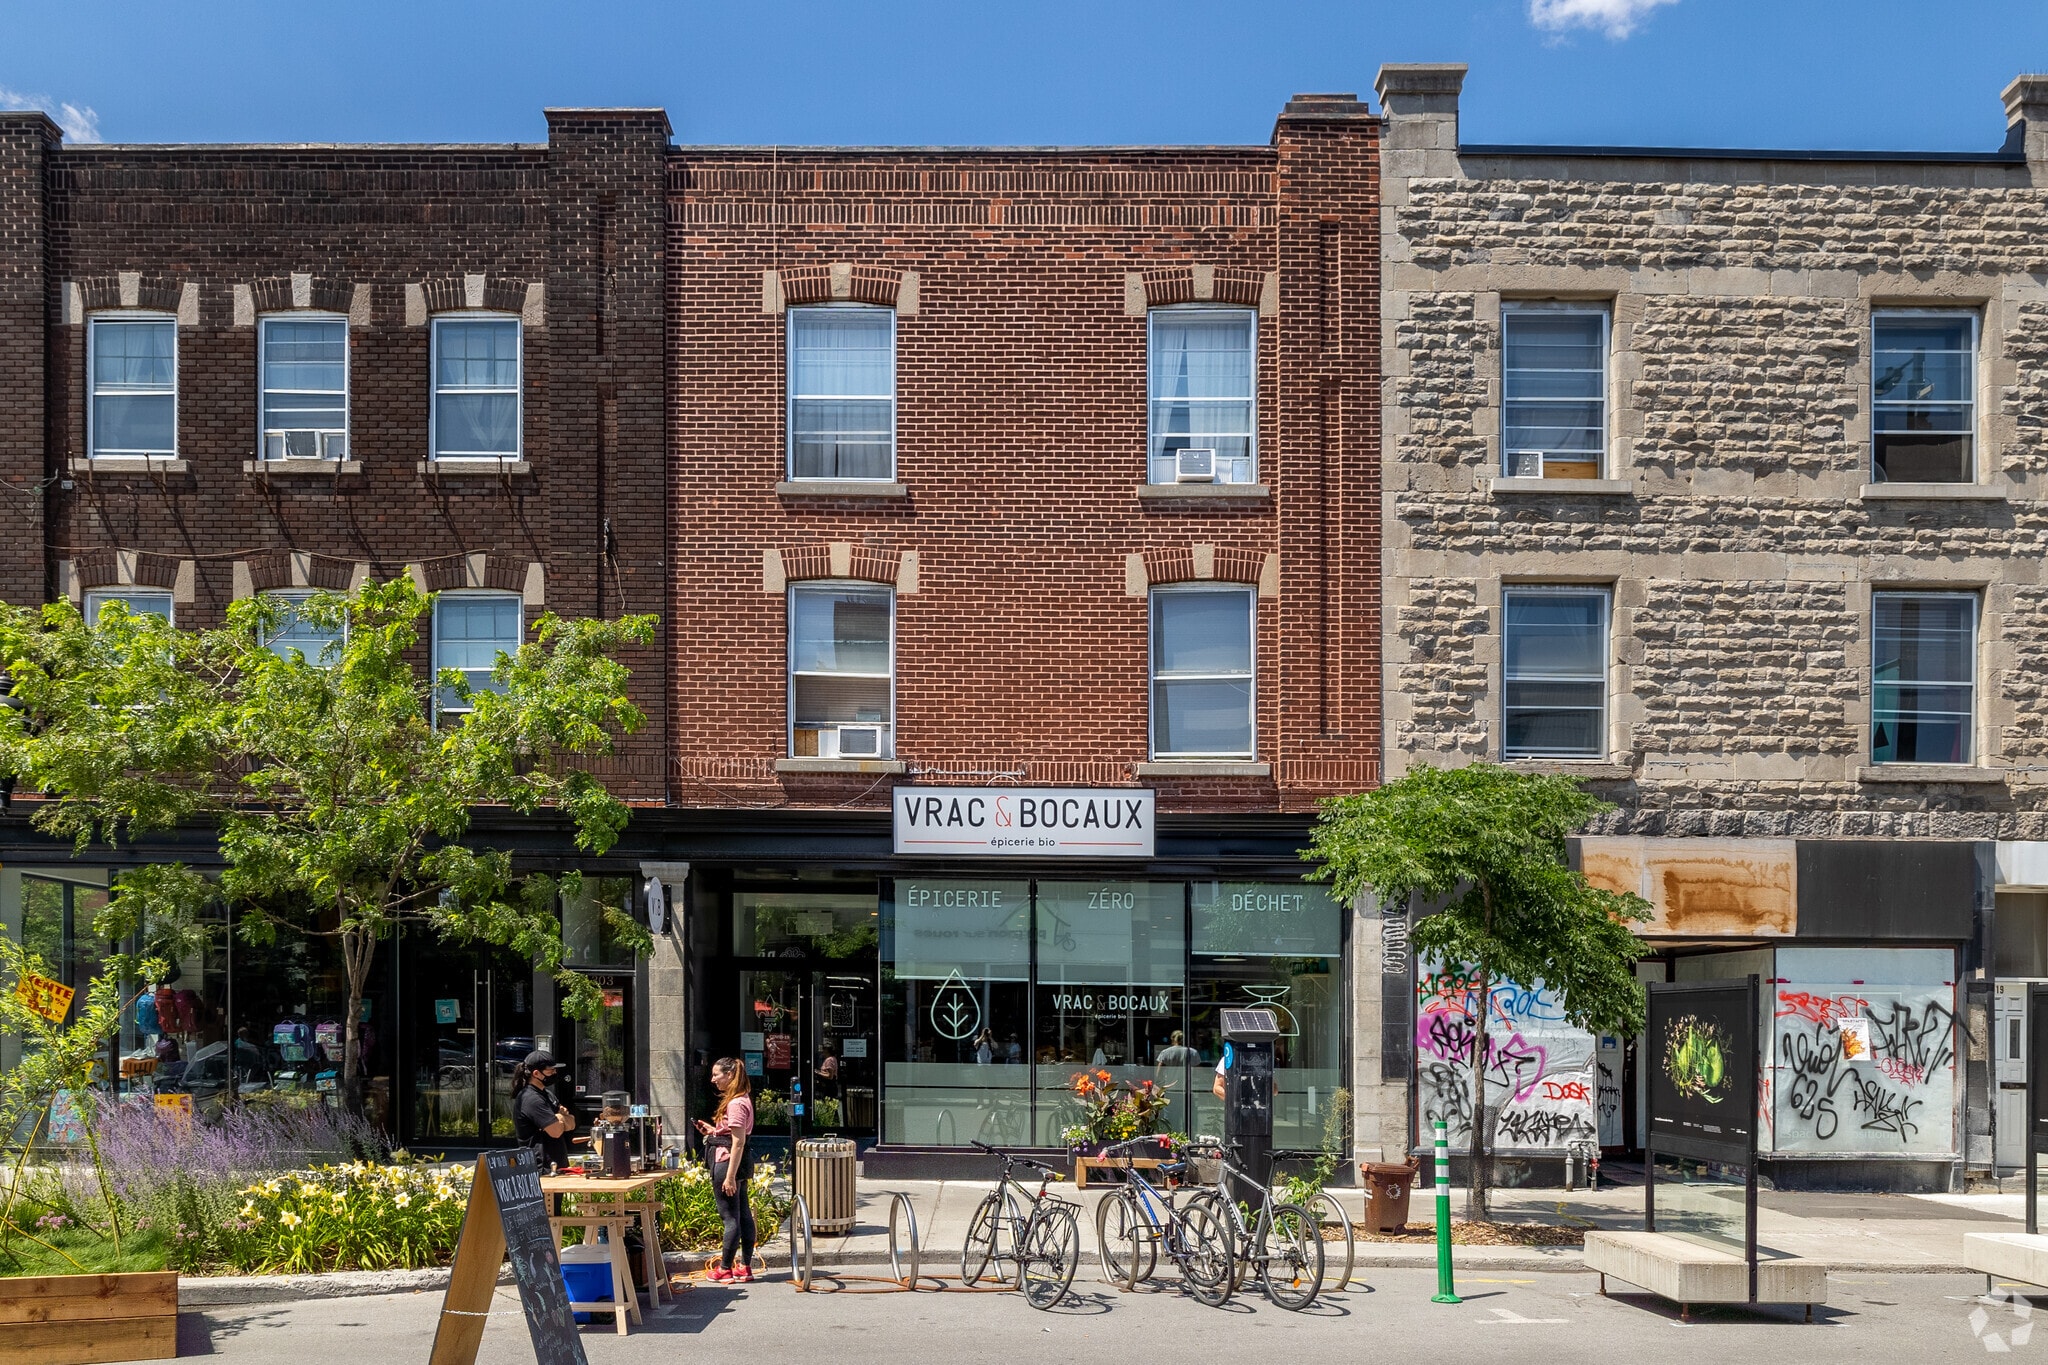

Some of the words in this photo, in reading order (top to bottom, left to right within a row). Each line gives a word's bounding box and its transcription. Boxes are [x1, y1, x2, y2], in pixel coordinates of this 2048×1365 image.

[904, 797, 985, 827] VRAC
[995, 795, 1012, 827] &
[1020, 799, 1142, 829] BOCAUX
[990, 837, 1036, 847] épicerie
[1038, 837, 1056, 847] bio
[907, 885, 1002, 909] ÉPICERIE
[1088, 887, 1135, 910] ZÉRO
[1232, 889, 1304, 912] DÉCHET
[1996, 985, 2004, 994] 19
[1052, 994, 1093, 1010] VRAC
[1096, 995, 1106, 1011] &
[1108, 995, 1169, 1011] BOCAUX
[494, 1178, 515, 1202] VRAC
